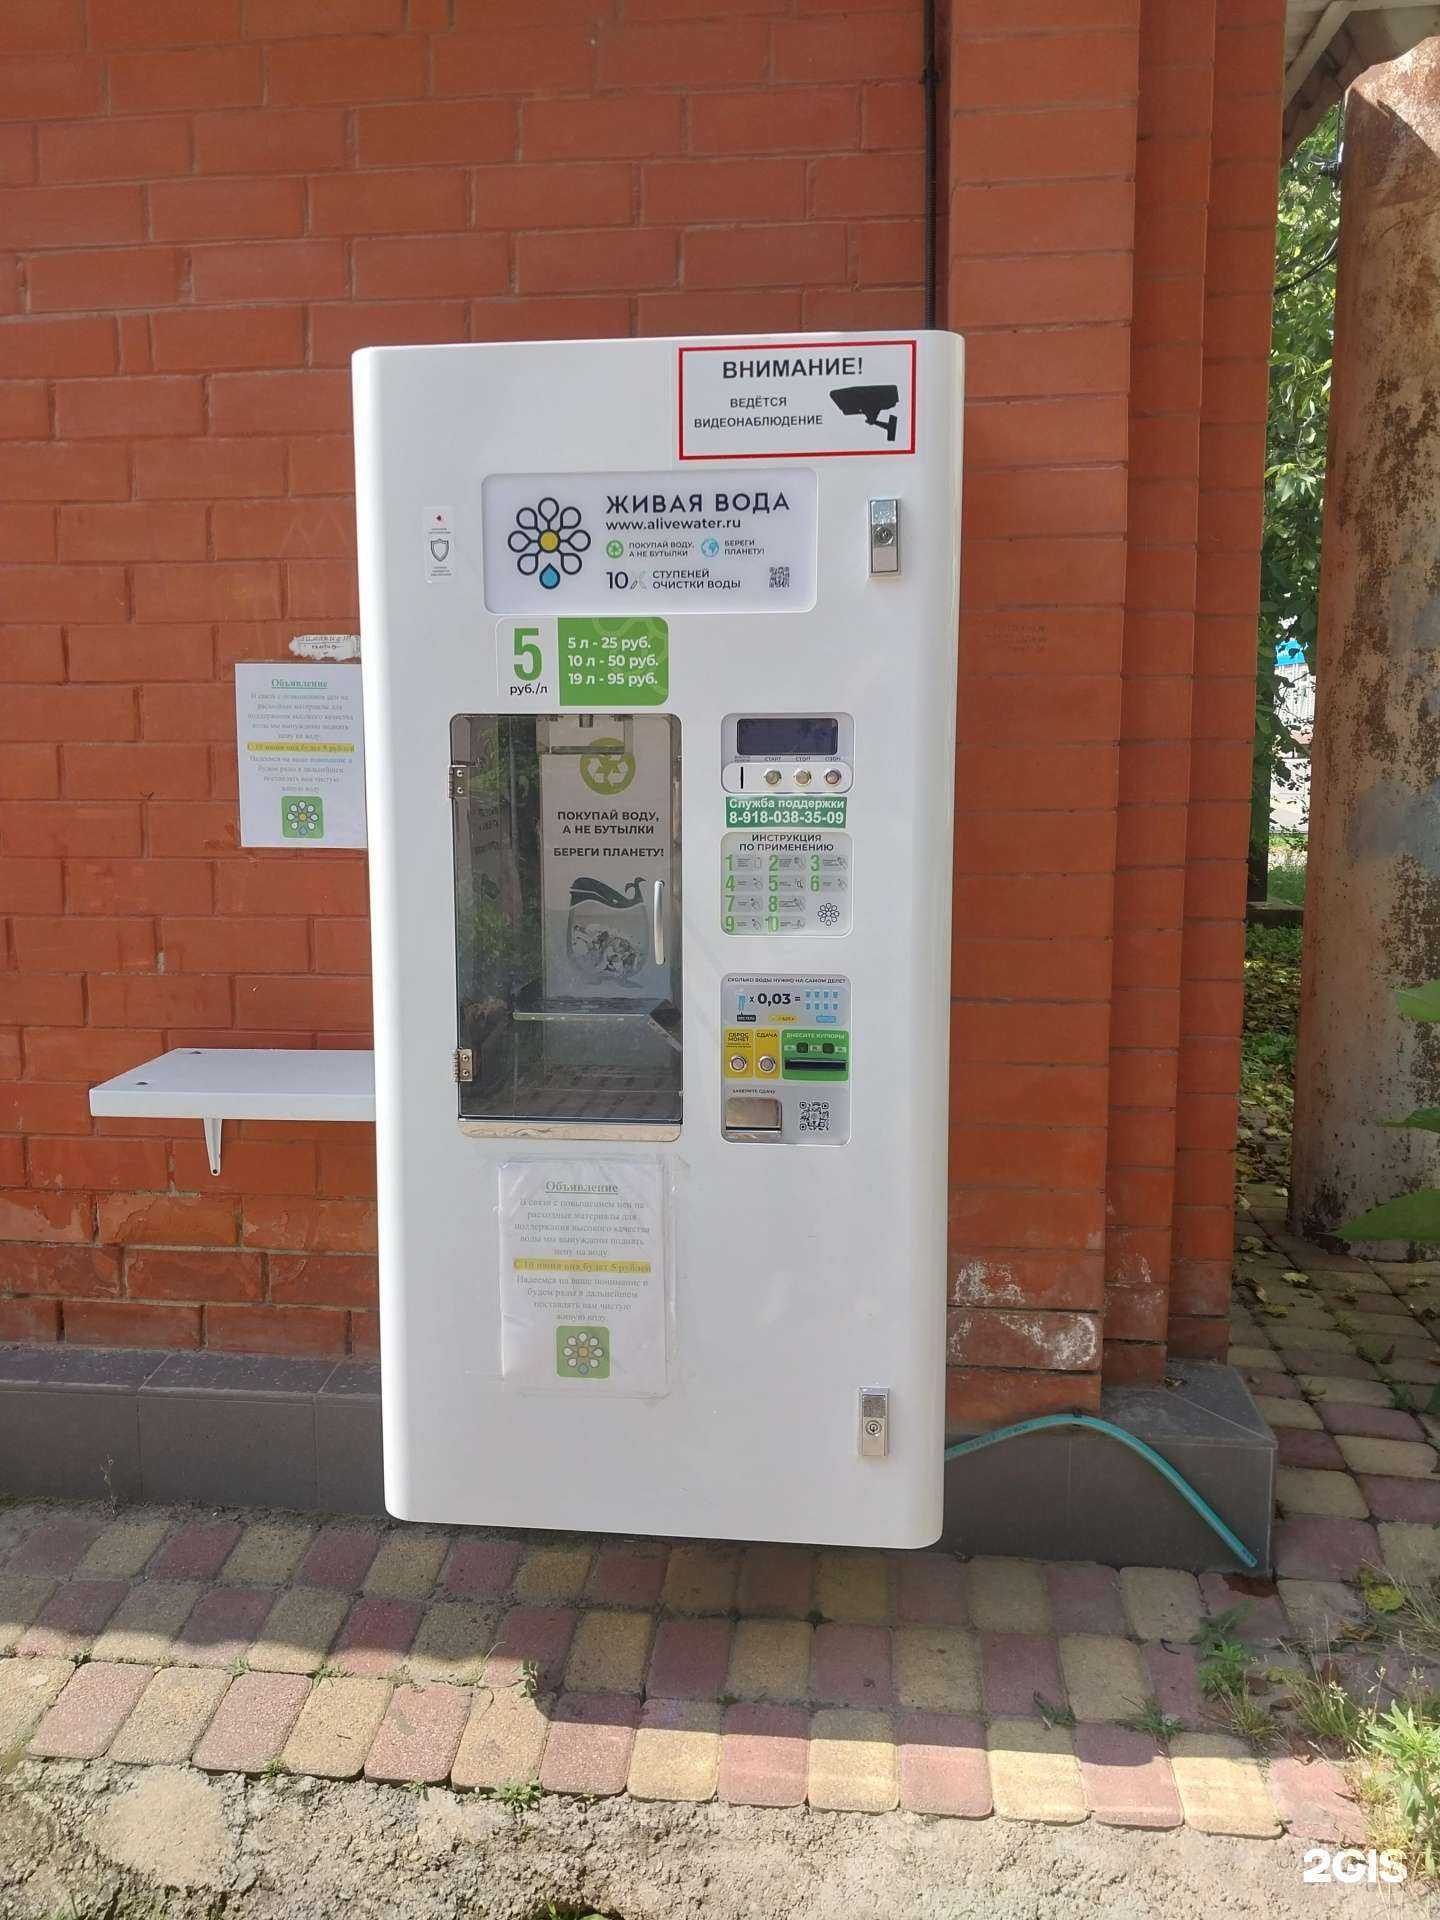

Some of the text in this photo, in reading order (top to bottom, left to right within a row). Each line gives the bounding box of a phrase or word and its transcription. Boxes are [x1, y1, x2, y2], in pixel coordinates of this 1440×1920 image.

[722, 357, 864, 379] ВНИМАНИЕ!
[730, 396, 787, 409] ВЕДЁТСЯ
[694, 414, 823, 429] ВИДЕОНАБЛЮДЕНИЕ
[606, 492, 790, 514] ЖИВАЯ ВОДА
[606, 517, 741, 531] www.alivewater.ru
[629, 540, 669, 549] ПОКУПАЙ
[724, 539, 755, 547] БЕРЕГИ
[629, 550, 688, 558] А НЕ БУТЫЛКИ
[724, 548, 765, 556] ПЛАНЕТУ!
[606, 571, 629, 590] 10
[652, 569, 710, 579] СТУПЕНЕЙ
[652, 580, 741, 590] ОЧИСТКИ ВОДЫ
[568, 637, 576, 649] 5
[579, 639, 589, 649] л
[601, 637, 618, 649] 25
[621, 636, 652, 652] руб.
[513, 627, 543, 682] 5
[568, 655, 582, 667] 10
[586, 657, 596, 667] л
[607, 655, 625, 667] 50
[629, 654, 659, 670] руб.
[568, 673, 583, 685] 19
[586, 675, 596, 685] л
[607, 673, 625, 685] 95
[628, 672, 659, 688] руб.
[509, 683, 548, 696] руб./л
[729, 798, 845, 810] Служба поддержки
[557, 809, 660, 822] ПОКУПАЙ ВОДУ,
[729, 810, 844, 824] 8-918-038-35-09
[562, 825, 654, 834] А НЕ БУТЫЛКИ
[752, 834, 822, 842] ИНСТРУКЦИЯ
[553, 847, 664, 857] БЕРЕГИ ПЛАНЕТУ!
[739, 843, 834, 851] ПО ПРИМЕНЕНИЮ
[725, 854, 733, 871] 1
[769, 854, 779, 871] 2
[810, 854, 820, 871] 3
[725, 875, 736, 892] 4
[769, 875, 778, 892] 5
[810, 875, 820, 892] 6
[725, 895, 736, 912] 7
[768, 895, 778, 913] 8
[725, 915, 735, 932] 9
[757, 993, 791, 1007] 0,03
[545, 1181, 619, 1194] Объявление
